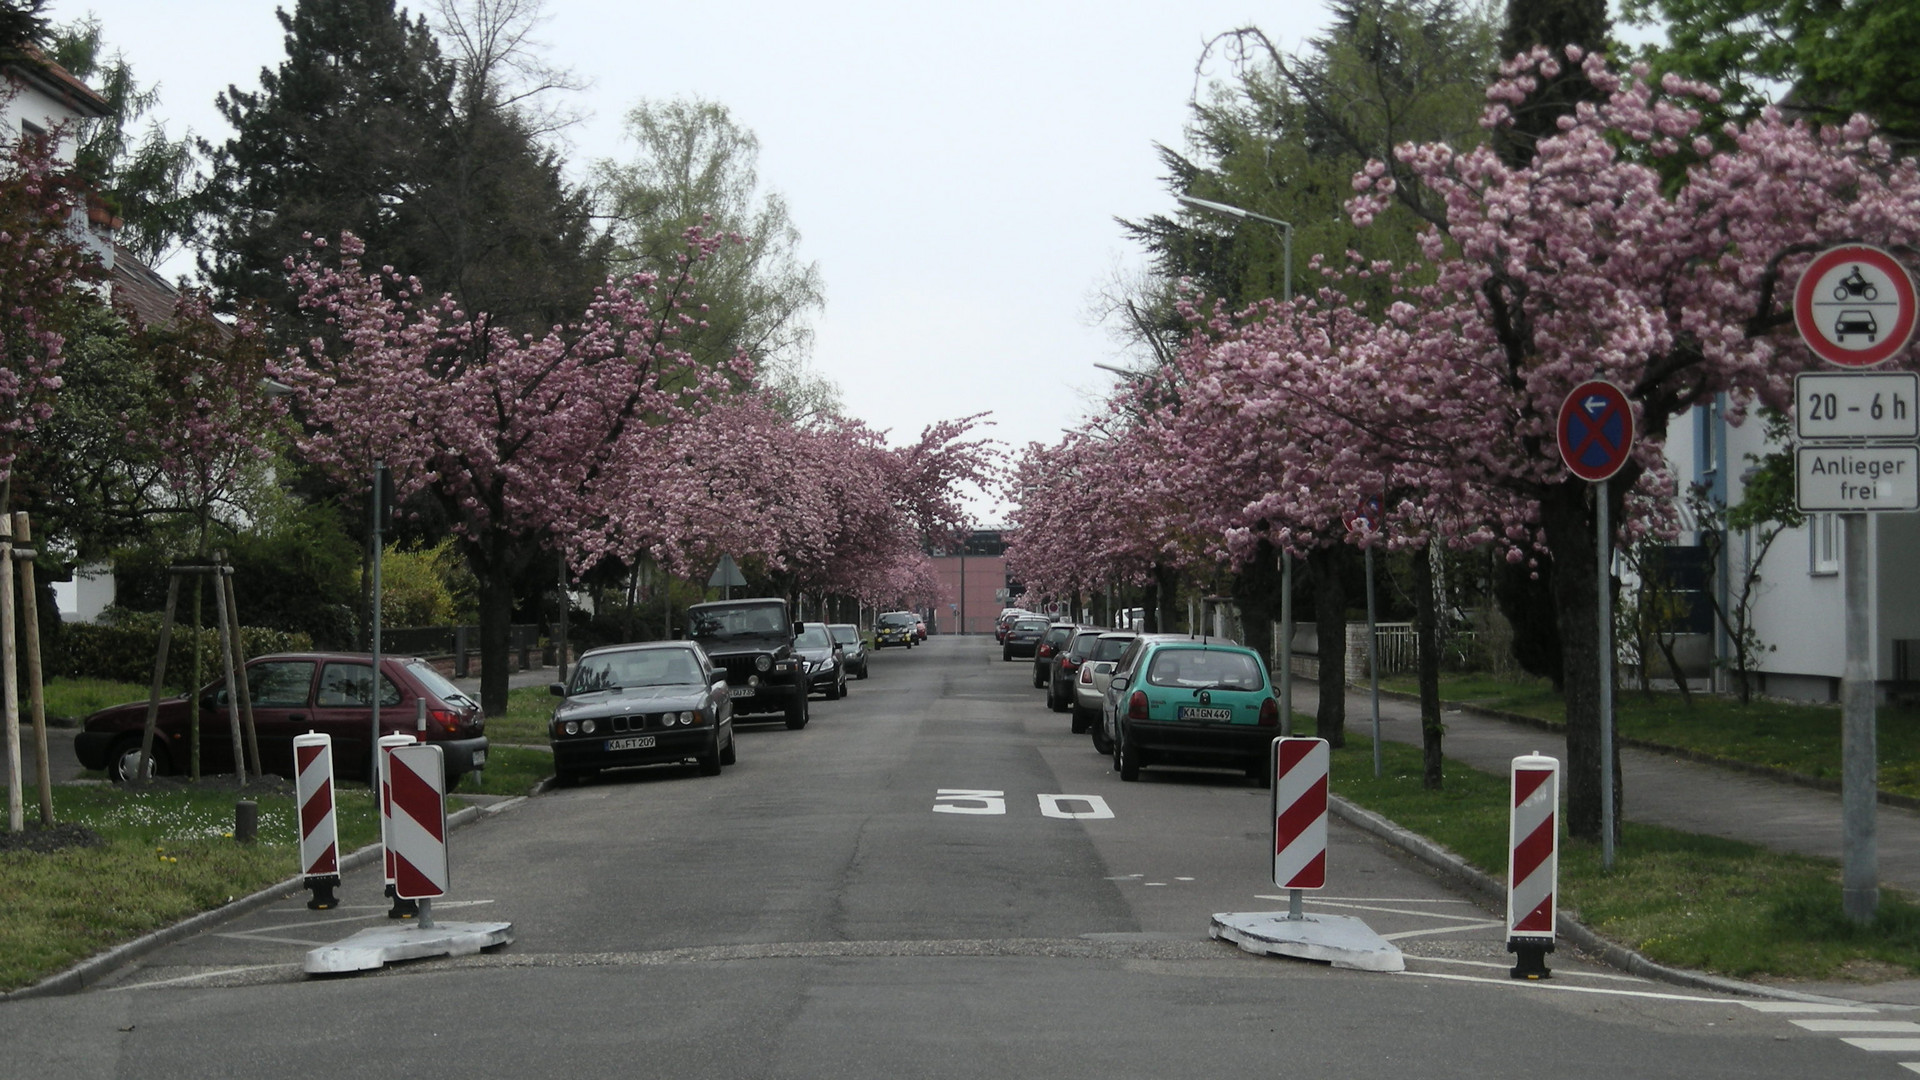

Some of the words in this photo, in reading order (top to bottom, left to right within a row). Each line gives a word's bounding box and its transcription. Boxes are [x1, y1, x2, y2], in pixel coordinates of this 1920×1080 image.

[1809, 393, 1837, 420] 20
[1871, 393, 1883, 420] 6
[1893, 393, 1906, 420] h
[1811, 456, 1906, 480] Anlieger
[1841, 480, 1877, 500] frei
[1183, 708, 1196, 717] KA
[1201, 709, 1213, 718] GN
[1213, 710, 1230, 719] 449
[609, 740, 621, 750] KA
[625, 739, 637, 748] FT
[638, 737, 655, 747] 209
[932, 788, 1115, 819] 30
